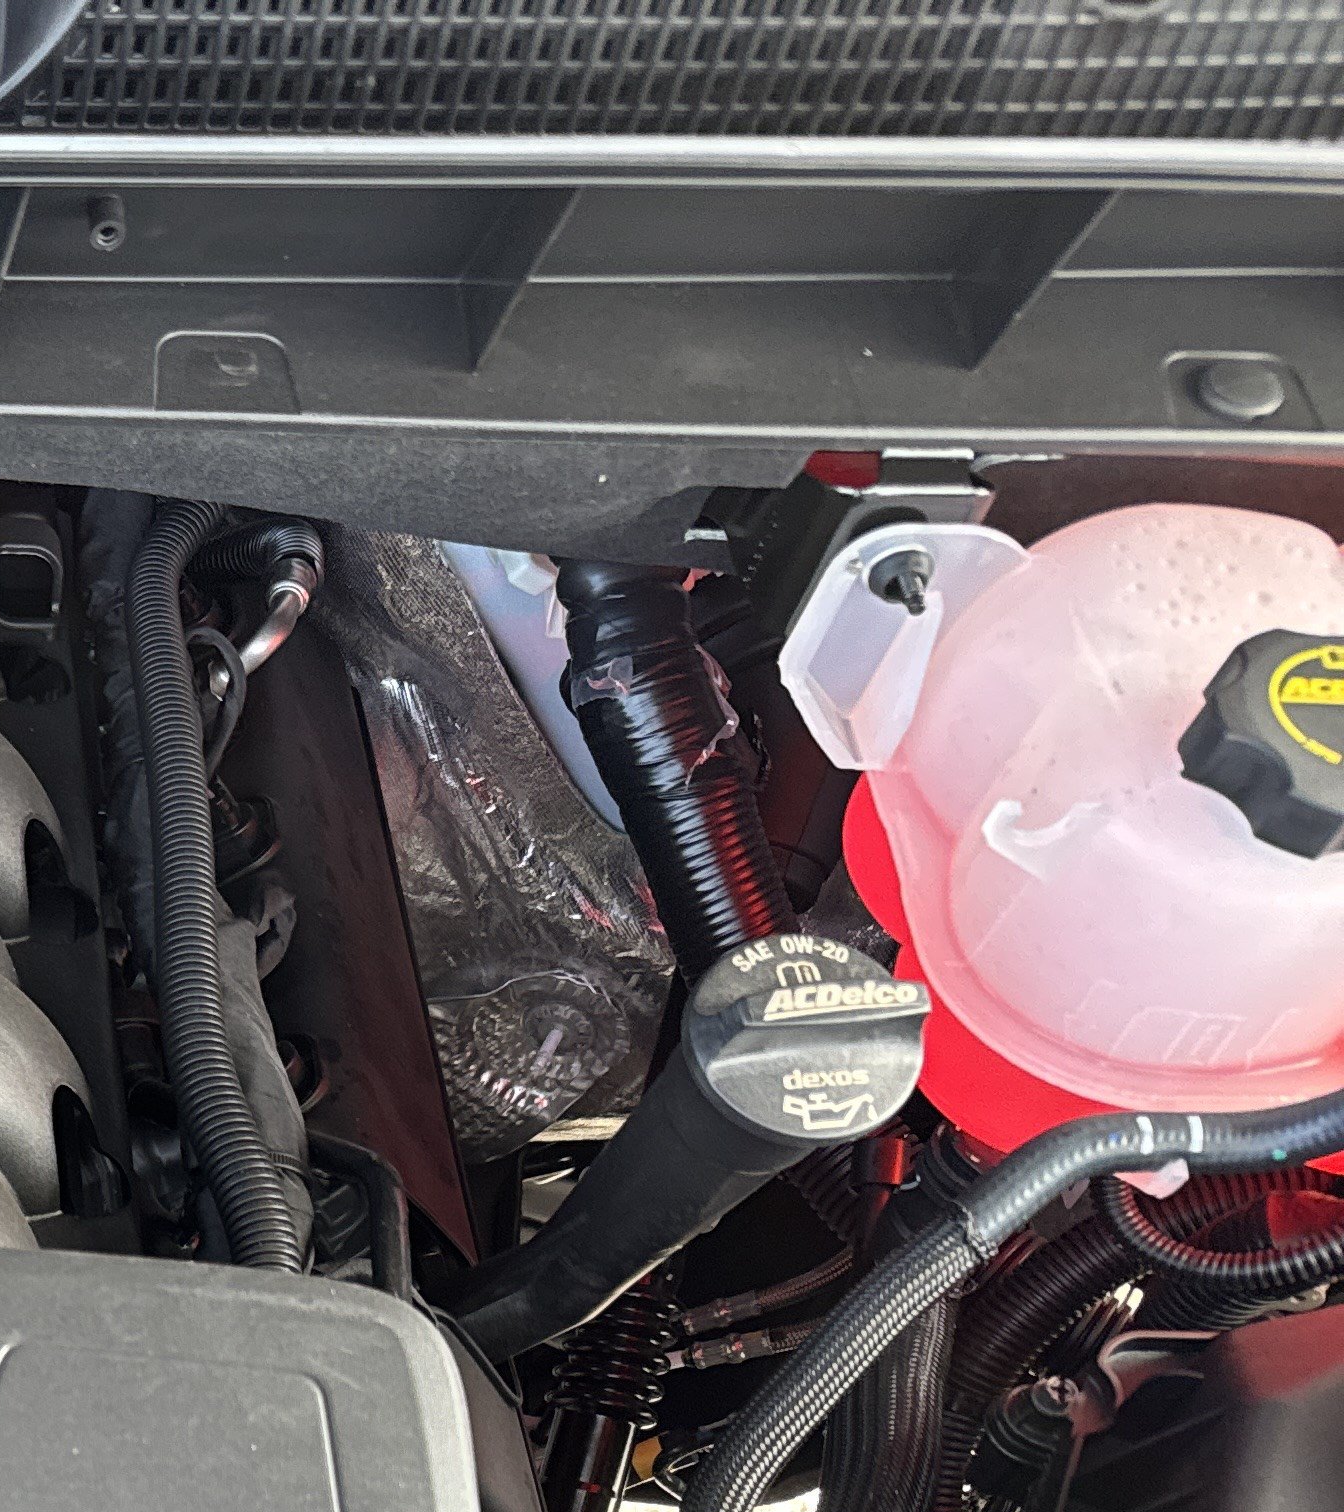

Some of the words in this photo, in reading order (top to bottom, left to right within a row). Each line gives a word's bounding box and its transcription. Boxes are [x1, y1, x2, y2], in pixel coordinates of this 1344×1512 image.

[731, 940, 775, 973] SAE
[779, 934, 850, 965] 0W-20
[763, 980, 919, 1017] ACDelco
[782, 1069, 871, 1091] dexos
